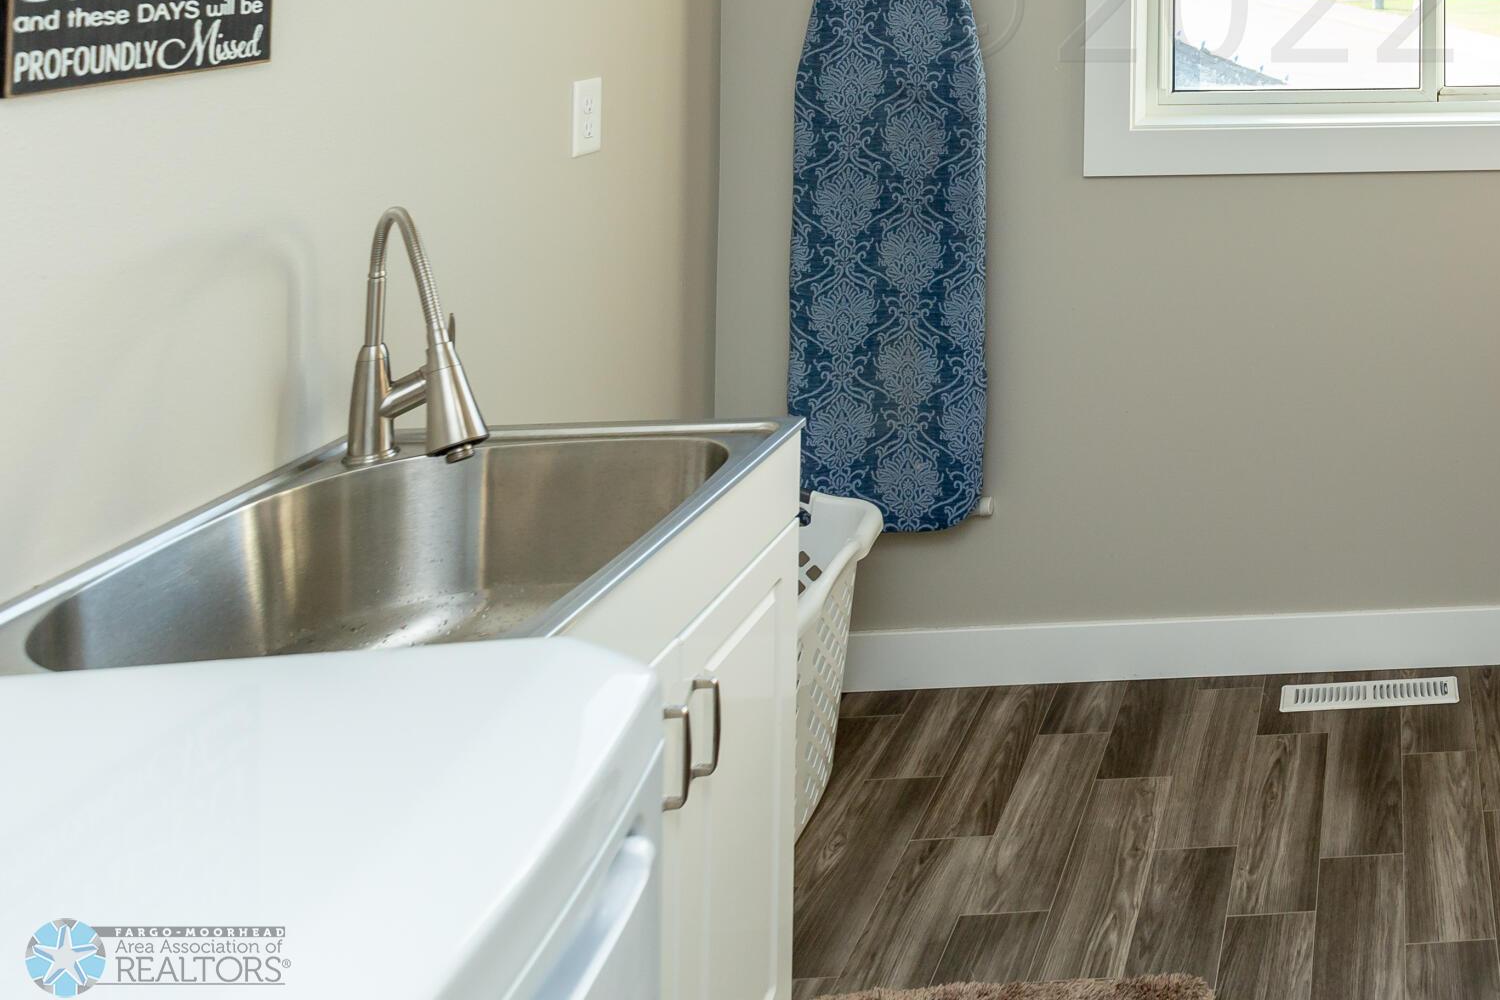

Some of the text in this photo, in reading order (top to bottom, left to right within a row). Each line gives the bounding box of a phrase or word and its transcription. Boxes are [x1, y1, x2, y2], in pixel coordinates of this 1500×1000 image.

[13, 10, 60, 33] and
[67, 7, 130, 27] these
[137, 0, 199, 23] DAYS
[14, 19, 264, 83] PROFOUNDLY Missed
